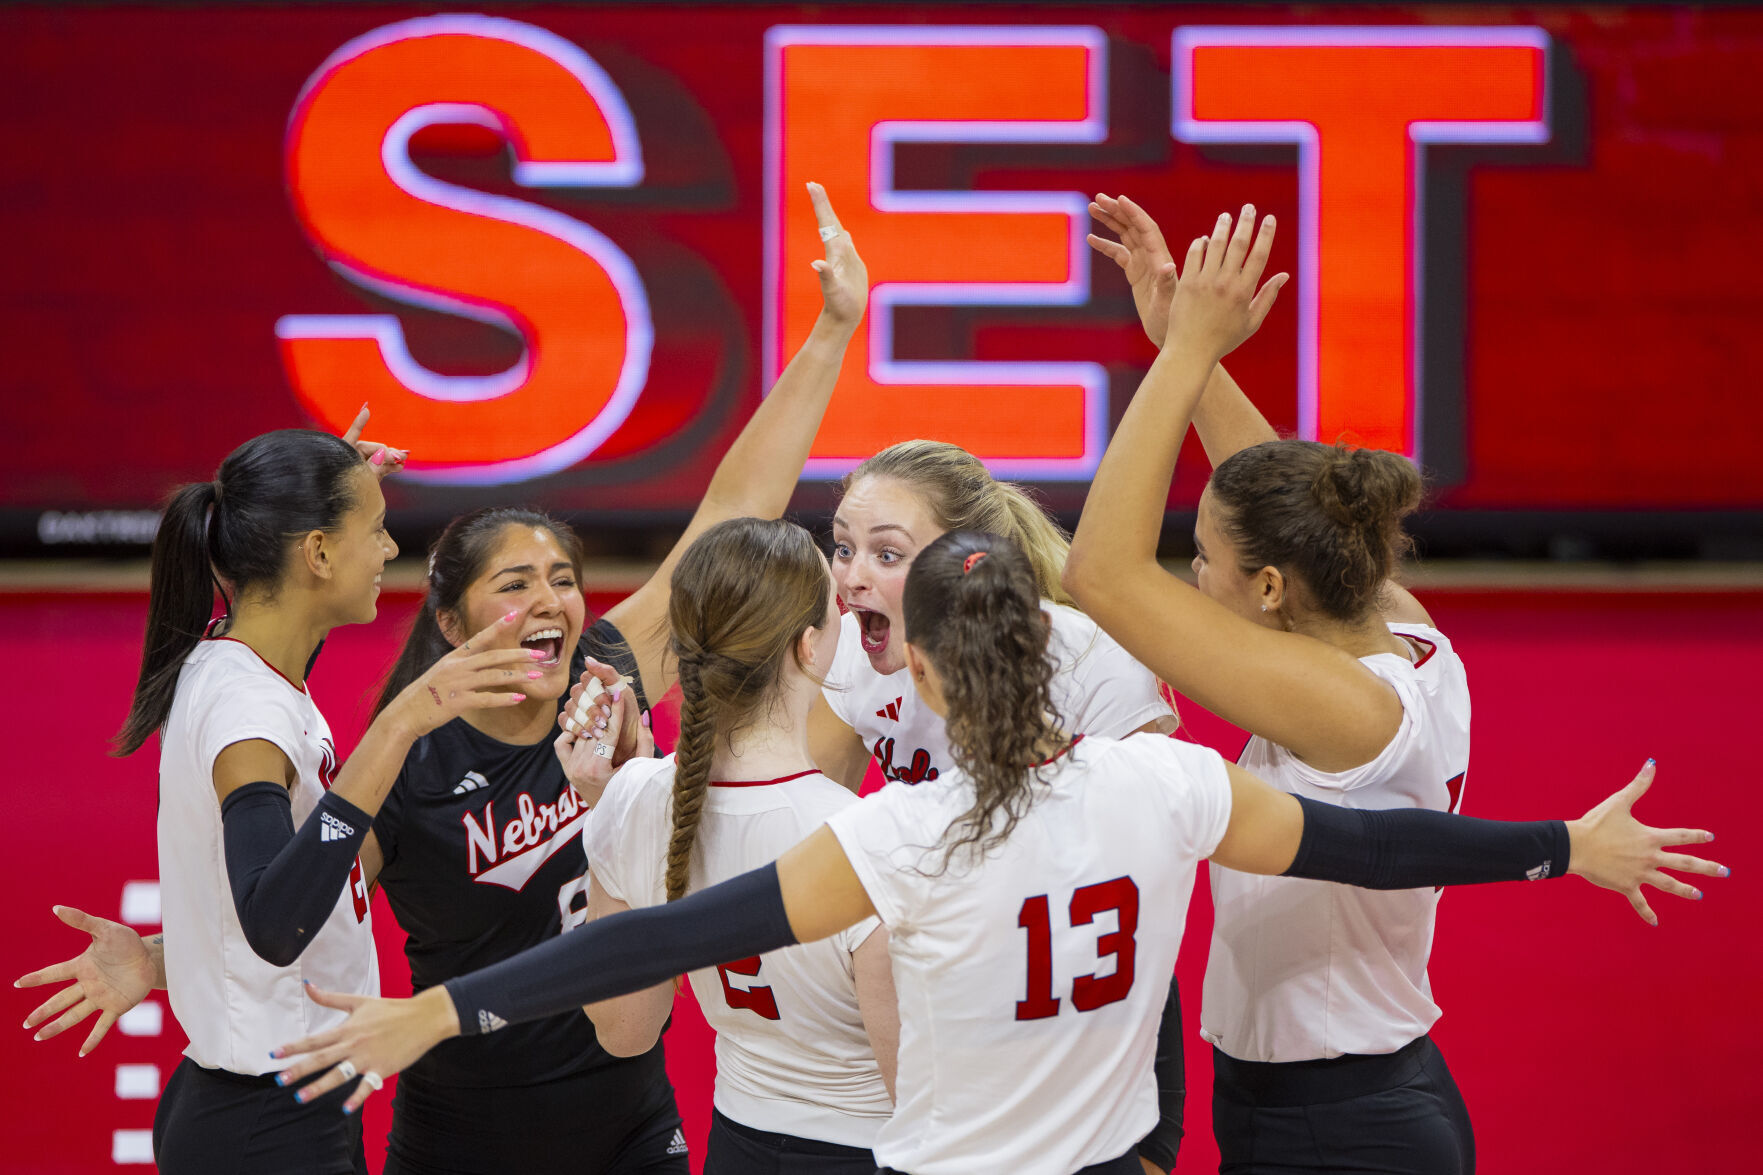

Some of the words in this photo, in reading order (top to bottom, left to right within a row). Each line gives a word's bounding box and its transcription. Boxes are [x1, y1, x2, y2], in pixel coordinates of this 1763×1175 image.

[275, 13, 1552, 486] SET
[321, 811, 354, 836] adidas
[1015, 875, 1140, 1021] 13
